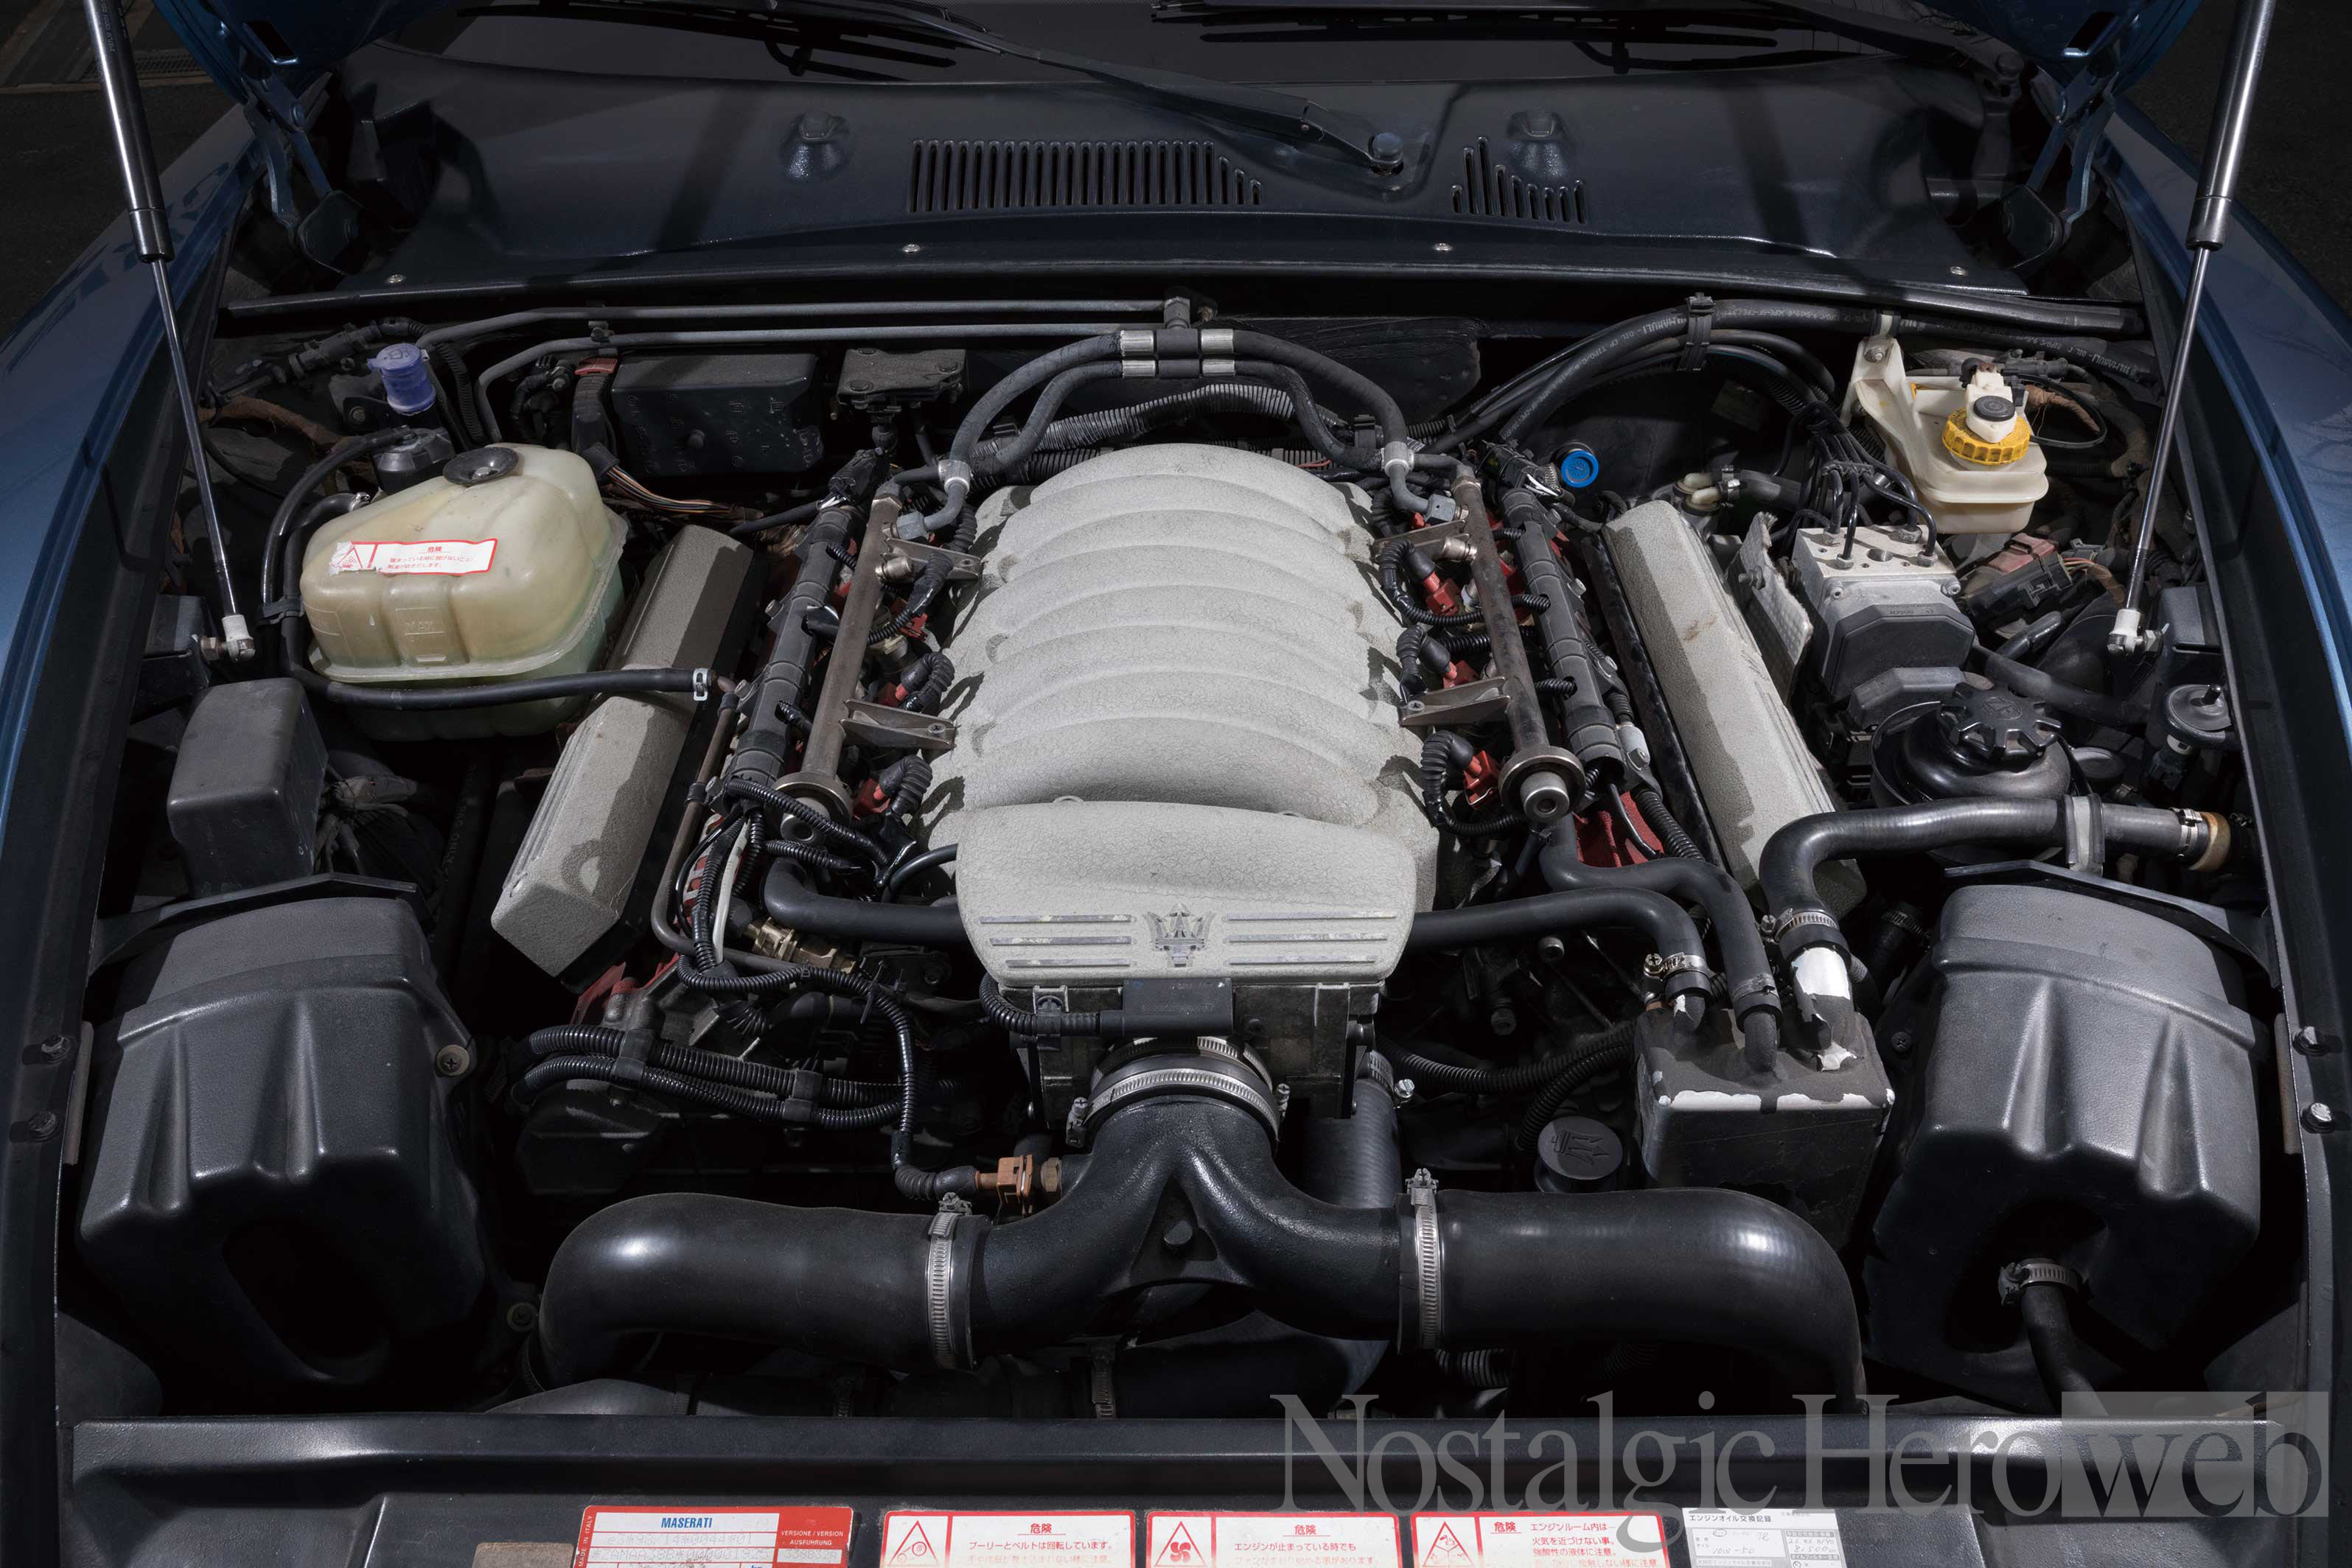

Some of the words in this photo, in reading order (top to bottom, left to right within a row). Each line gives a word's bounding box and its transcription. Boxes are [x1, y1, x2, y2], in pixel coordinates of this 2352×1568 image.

[660, 1517, 713, 1528] MASERATI
[1689, 1515, 1772, 1523] エンジンオイル交換記録
[1030, 1523, 1053, 1534] 危険
[1294, 1525, 1317, 1536] 危険
[1493, 1522, 1517, 1533] 危険
[579, 1548, 587, 1567] MADE
[584, 1515, 593, 1534] ITALY
[1532, 1537, 1615, 1546] 火気を近づけない事。
[1234, 1542, 1357, 1552] エンジンが止まっている時でも
[1532, 1547, 1616, 1556] 強酸性の液体に注意。
